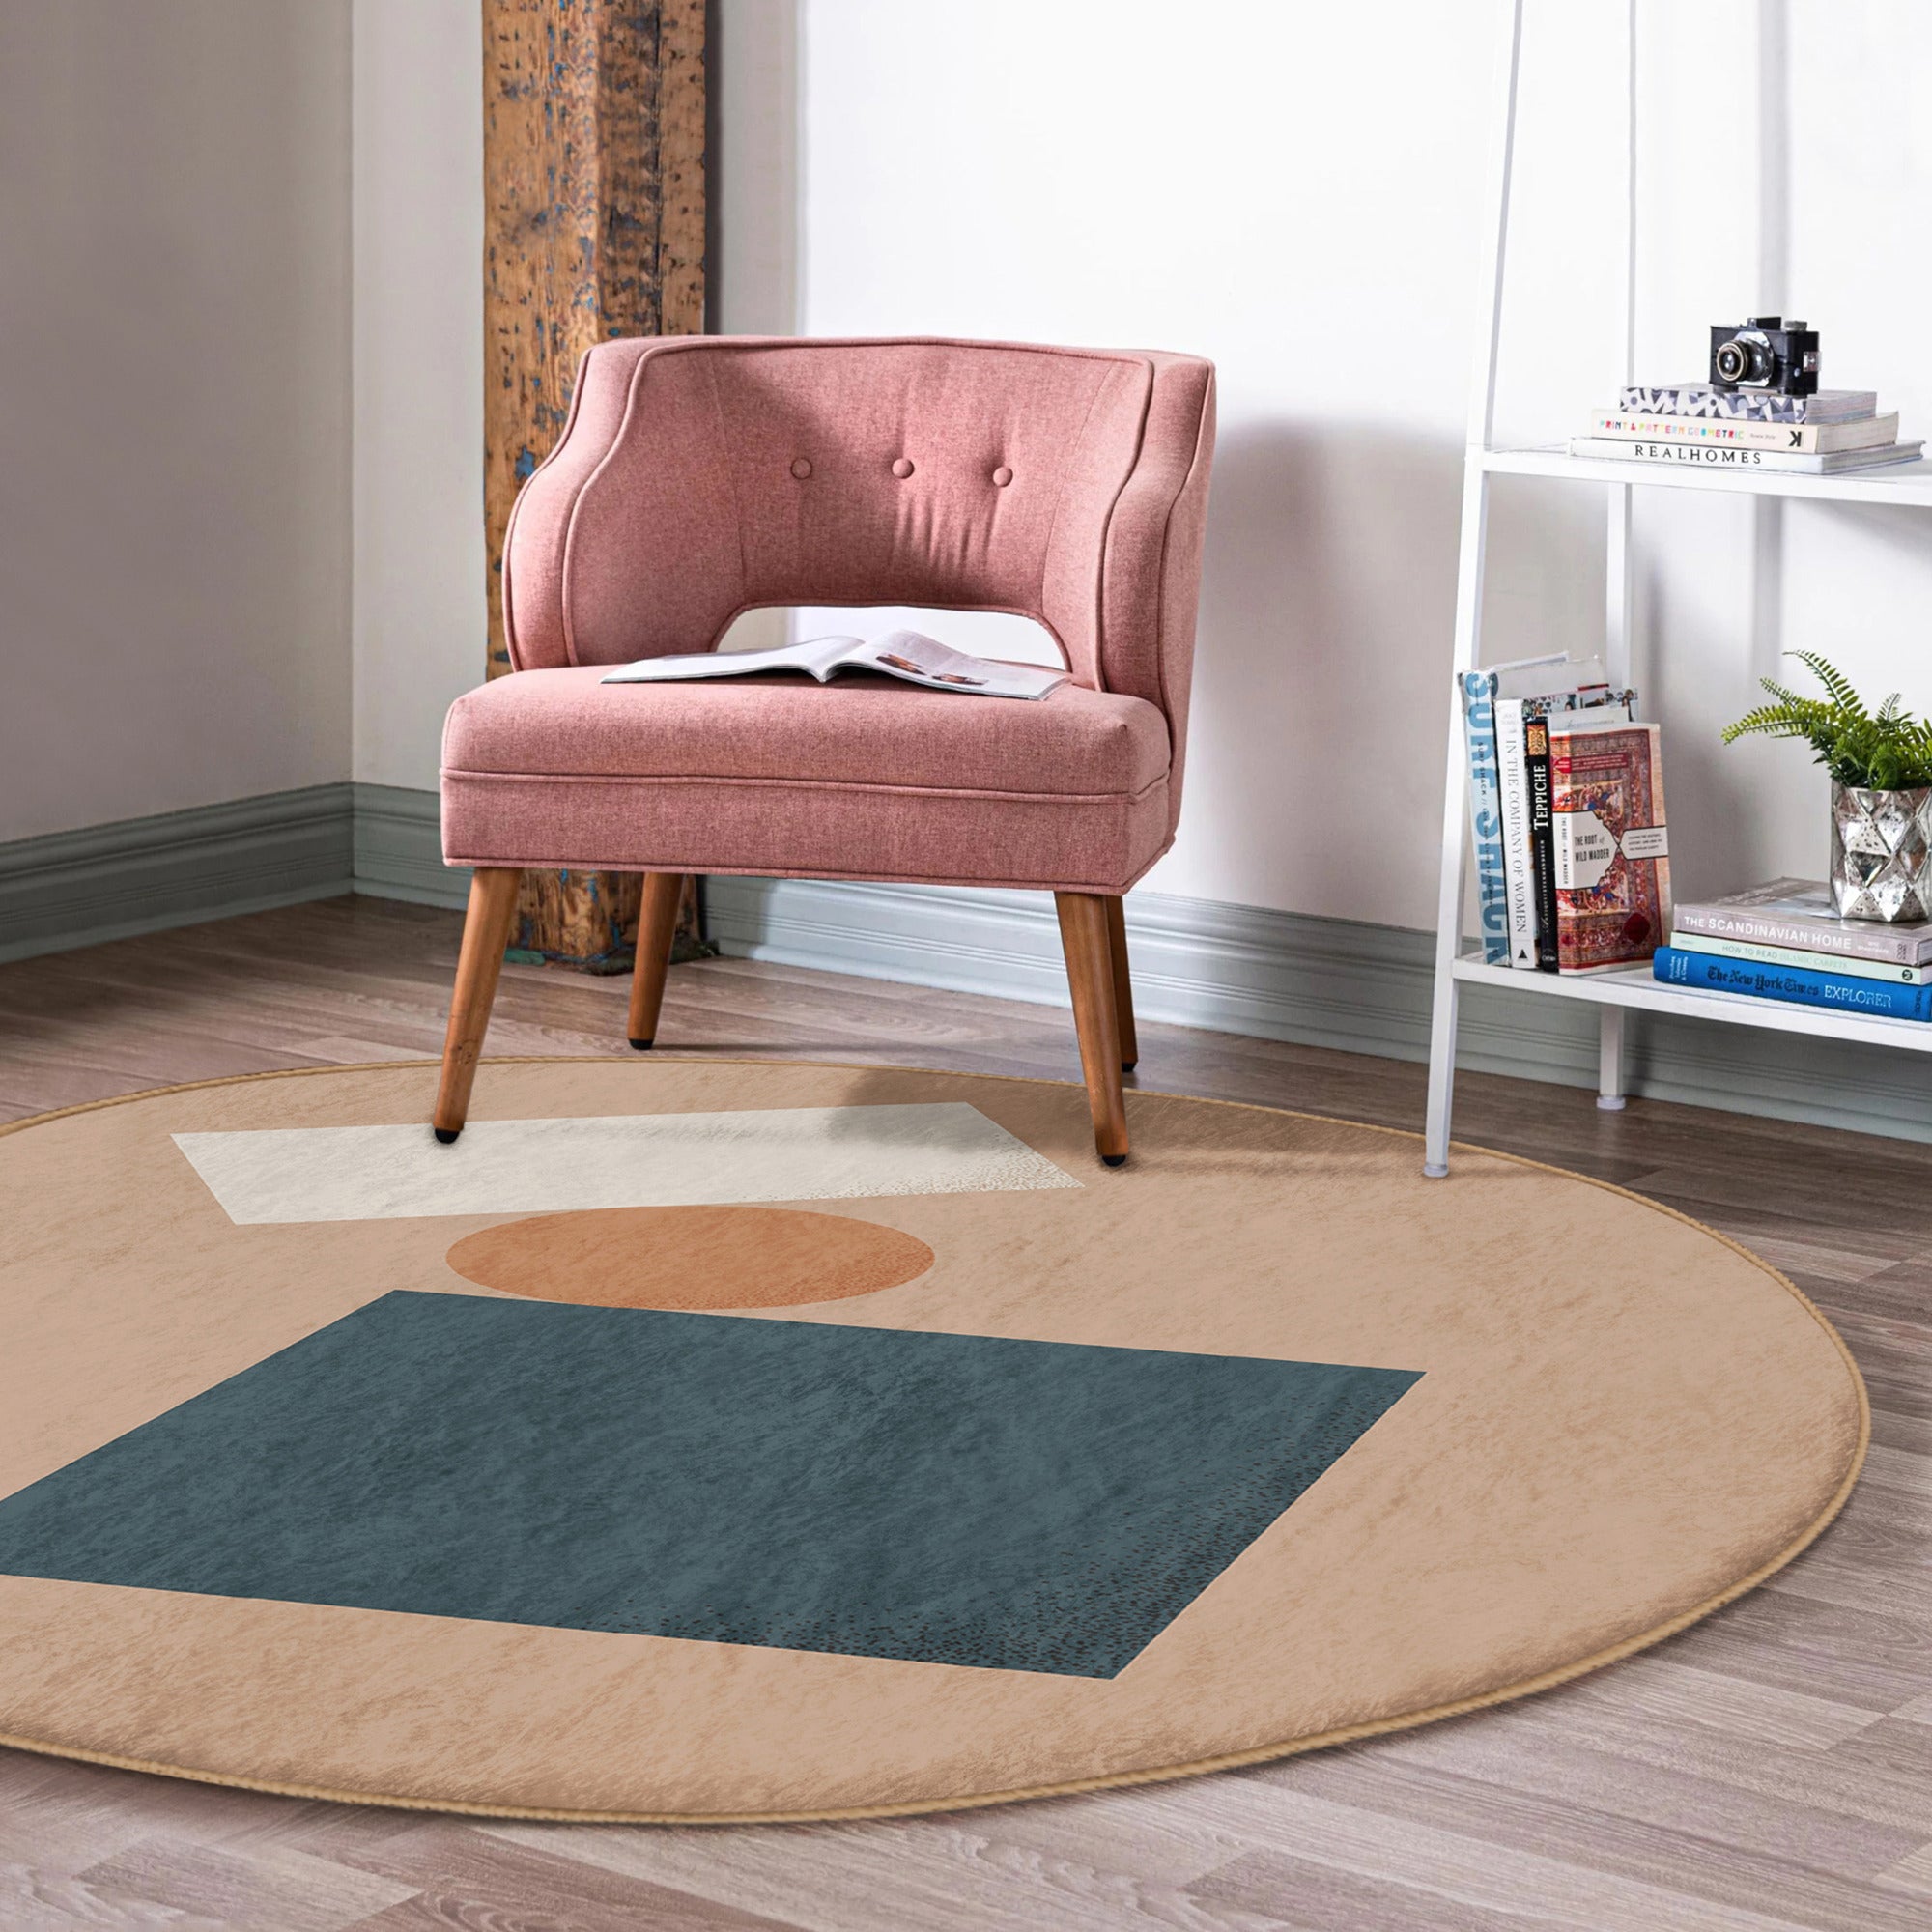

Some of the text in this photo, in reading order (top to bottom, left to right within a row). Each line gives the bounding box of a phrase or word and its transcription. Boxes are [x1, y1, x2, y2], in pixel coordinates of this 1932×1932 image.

[1600, 419, 1745, 440] PRINT & PATTERN GEOMETRIC
[1634, 444, 1761, 464] REALHOMES
[1506, 740, 1517, 753] IN
[1507, 758, 1520, 786] THE
[1509, 790, 1522, 858] COMPANY
[1574, 836, 1583, 846] THE
[1584, 834, 1597, 845] ROOT
[1575, 848, 1609, 862] WILD MADDER
[1512, 860, 1524, 877] OF
[1514, 881, 1527, 933] WOMEN
[1684, 916, 1704, 927] THE
[1708, 918, 1808, 942] SCANDINAVIAN
[1811, 933, 1852, 950] HOME
[1722, 945, 1742, 954] HOW
[1745, 947, 1755, 956] TO
[1756, 949, 1777, 959] READ
[1707, 965, 1819, 996] The New York Times
[1824, 985, 1892, 1008] EXPLORER
